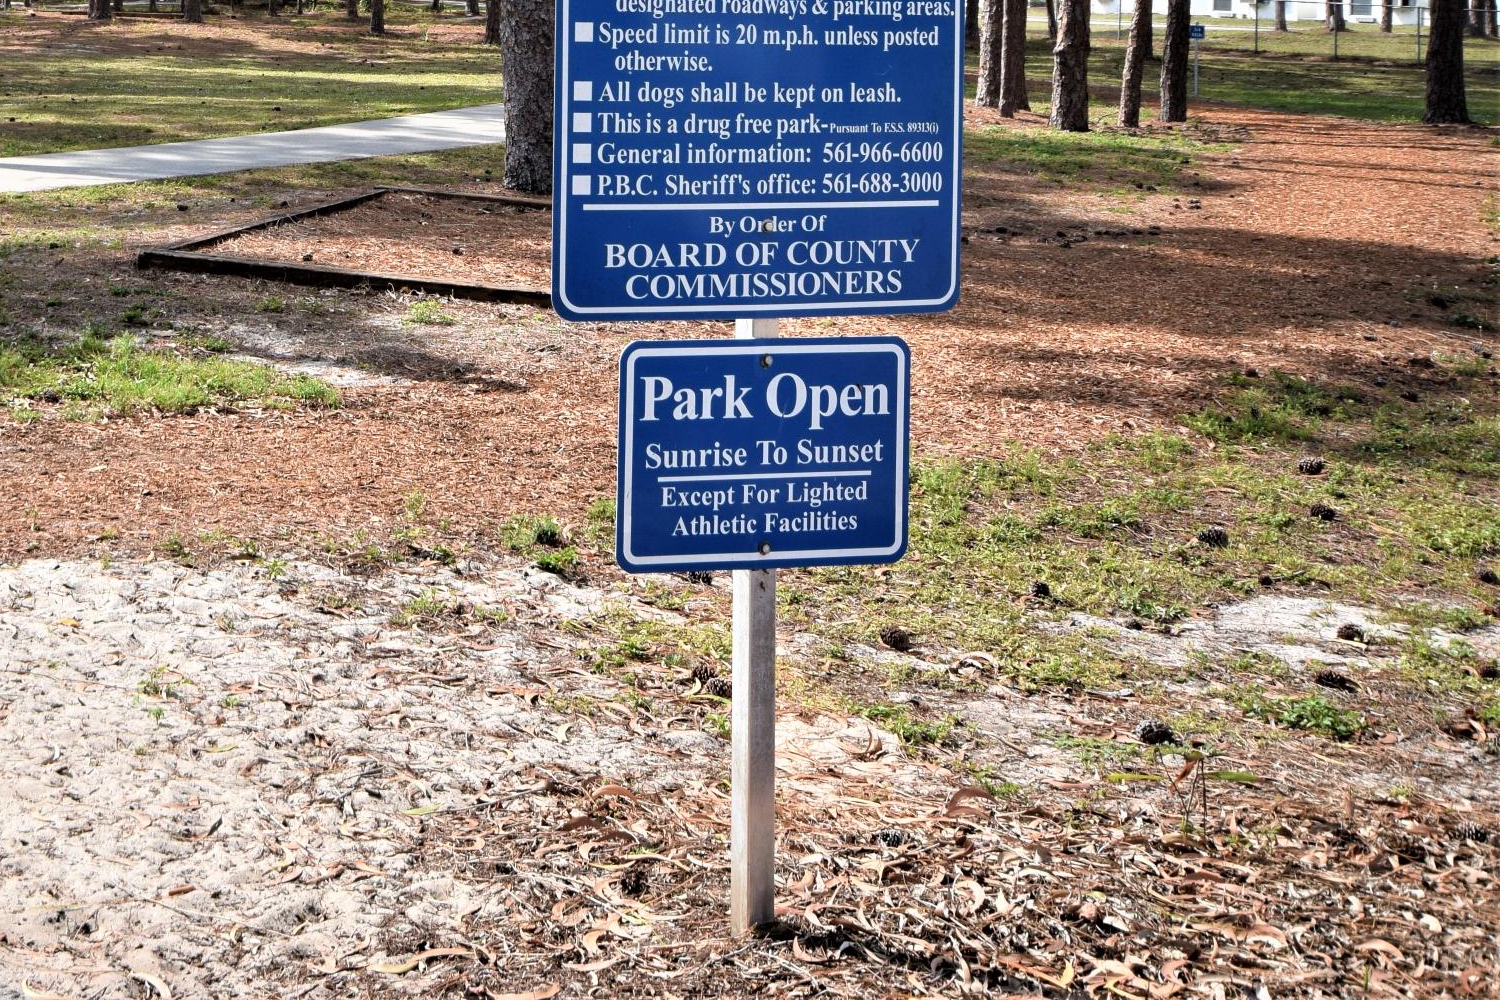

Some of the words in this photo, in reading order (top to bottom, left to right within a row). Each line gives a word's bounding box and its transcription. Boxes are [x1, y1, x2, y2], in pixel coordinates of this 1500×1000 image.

[599, 22, 657, 50] Speed
[665, 23, 710, 44] limit
[716, 24, 729, 44] is
[736, 24, 757, 44] 20
[763, 25, 818, 51] m.p.h.
[825, 25, 878, 45] unless
[884, 26, 938, 51] posted
[614, 48, 712, 72] otherwise.
[599, 81, 630, 101] All
[638, 82, 683, 108] dogs
[691, 82, 737, 102] shall
[745, 82, 766, 102] be
[774, 82, 815, 108] kept
[822, 88, 843, 102] on
[851, 83, 901, 102] leash.
[598, 113, 641, 133] This
[646, 113, 661, 133] is
[667, 119, 677, 133] a
[684, 113, 730, 139] drug
[736, 113, 771, 133] free
[830, 123, 868, 133] Pursuant
[871, 123, 881, 132] To
[598, 143, 680, 164] General
[688, 143, 810, 163] information:
[823, 142, 942, 163] 561-966-6600
[598, 175, 657, 195] P.B.C.
[666, 174, 750, 195] Sheriff's
[757, 174, 815, 194] office:
[823, 172, 942, 193] 561-688-3000
[710, 217, 735, 238] By
[802, 215, 827, 231] Of
[605, 243, 726, 267] BOARD
[736, 242, 778, 266] OF
[787, 239, 919, 265] COUNTY
[626, 270, 904, 301] COMMISSIONERS
[640, 375, 753, 421] Park
[766, 373, 890, 430] Open
[646, 442, 747, 469] Sunrise
[756, 441, 787, 464] To
[797, 439, 883, 464] Sunset
[661, 487, 735, 510] Except
[742, 484, 780, 504] For
[787, 481, 867, 507] Lighted
[672, 514, 756, 536] Athletic
[764, 511, 857, 532] Facilities
